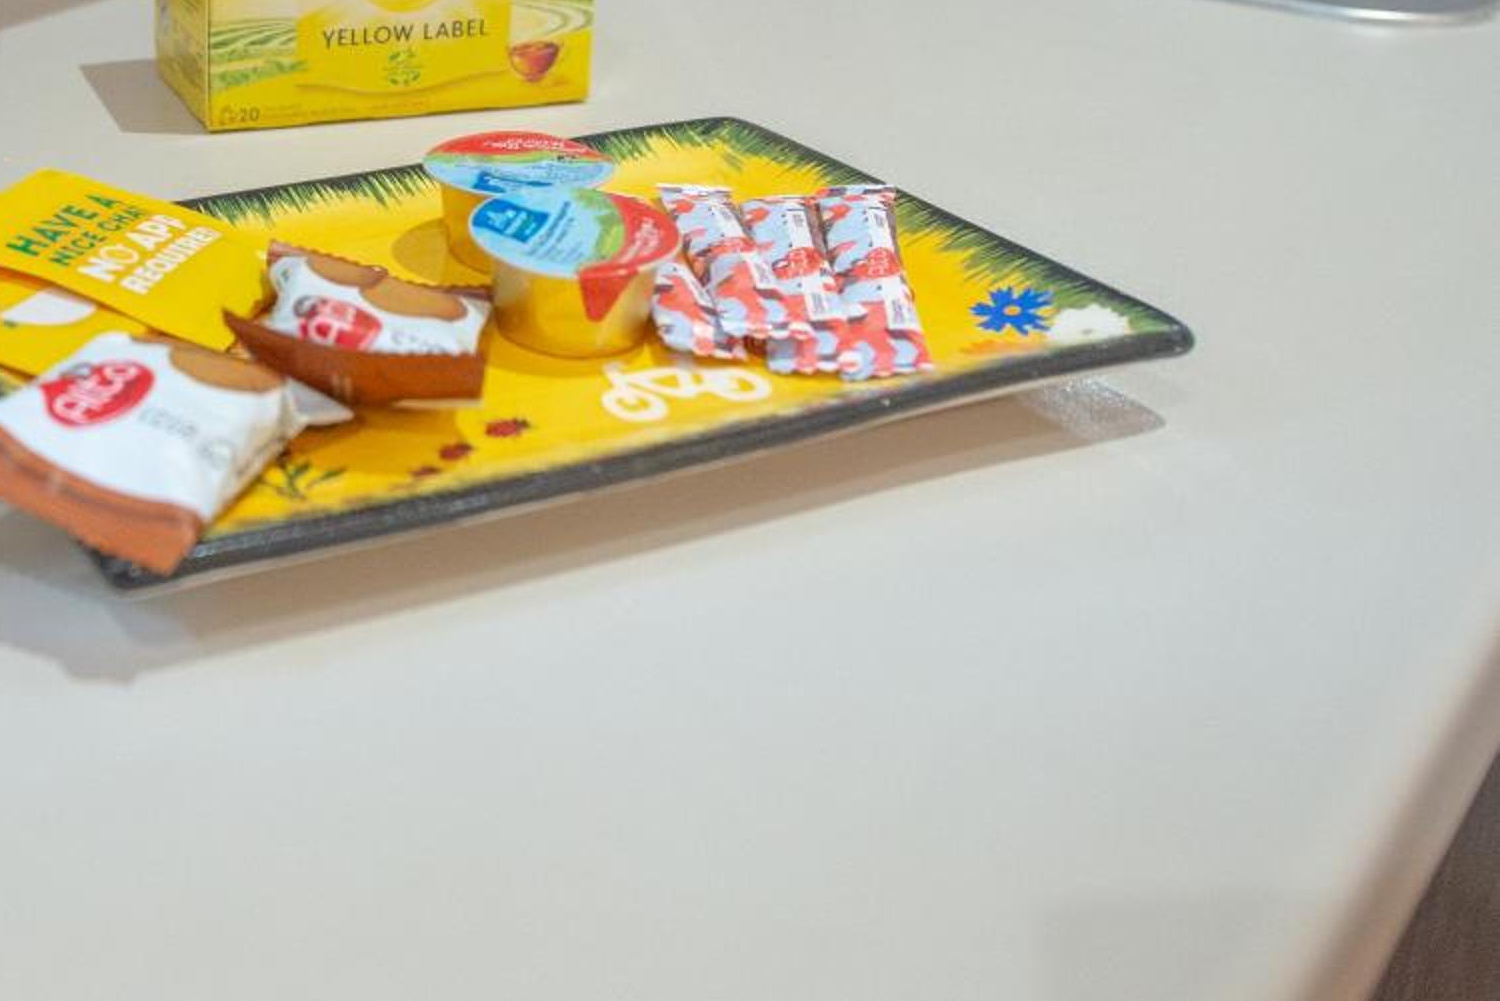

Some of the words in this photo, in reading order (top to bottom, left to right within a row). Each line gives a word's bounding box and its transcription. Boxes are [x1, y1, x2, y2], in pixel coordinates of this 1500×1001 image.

[323, 24, 414, 49] YELLOW
[423, 18, 490, 40] LABEL
[240, 106, 260, 122] 20
[5, 204, 99, 257] HAVE
[85, 194, 124, 209] A
[49, 230, 107, 267] NICE
[77, 243, 140, 283] NO
[120, 227, 222, 296] REQUIRED
